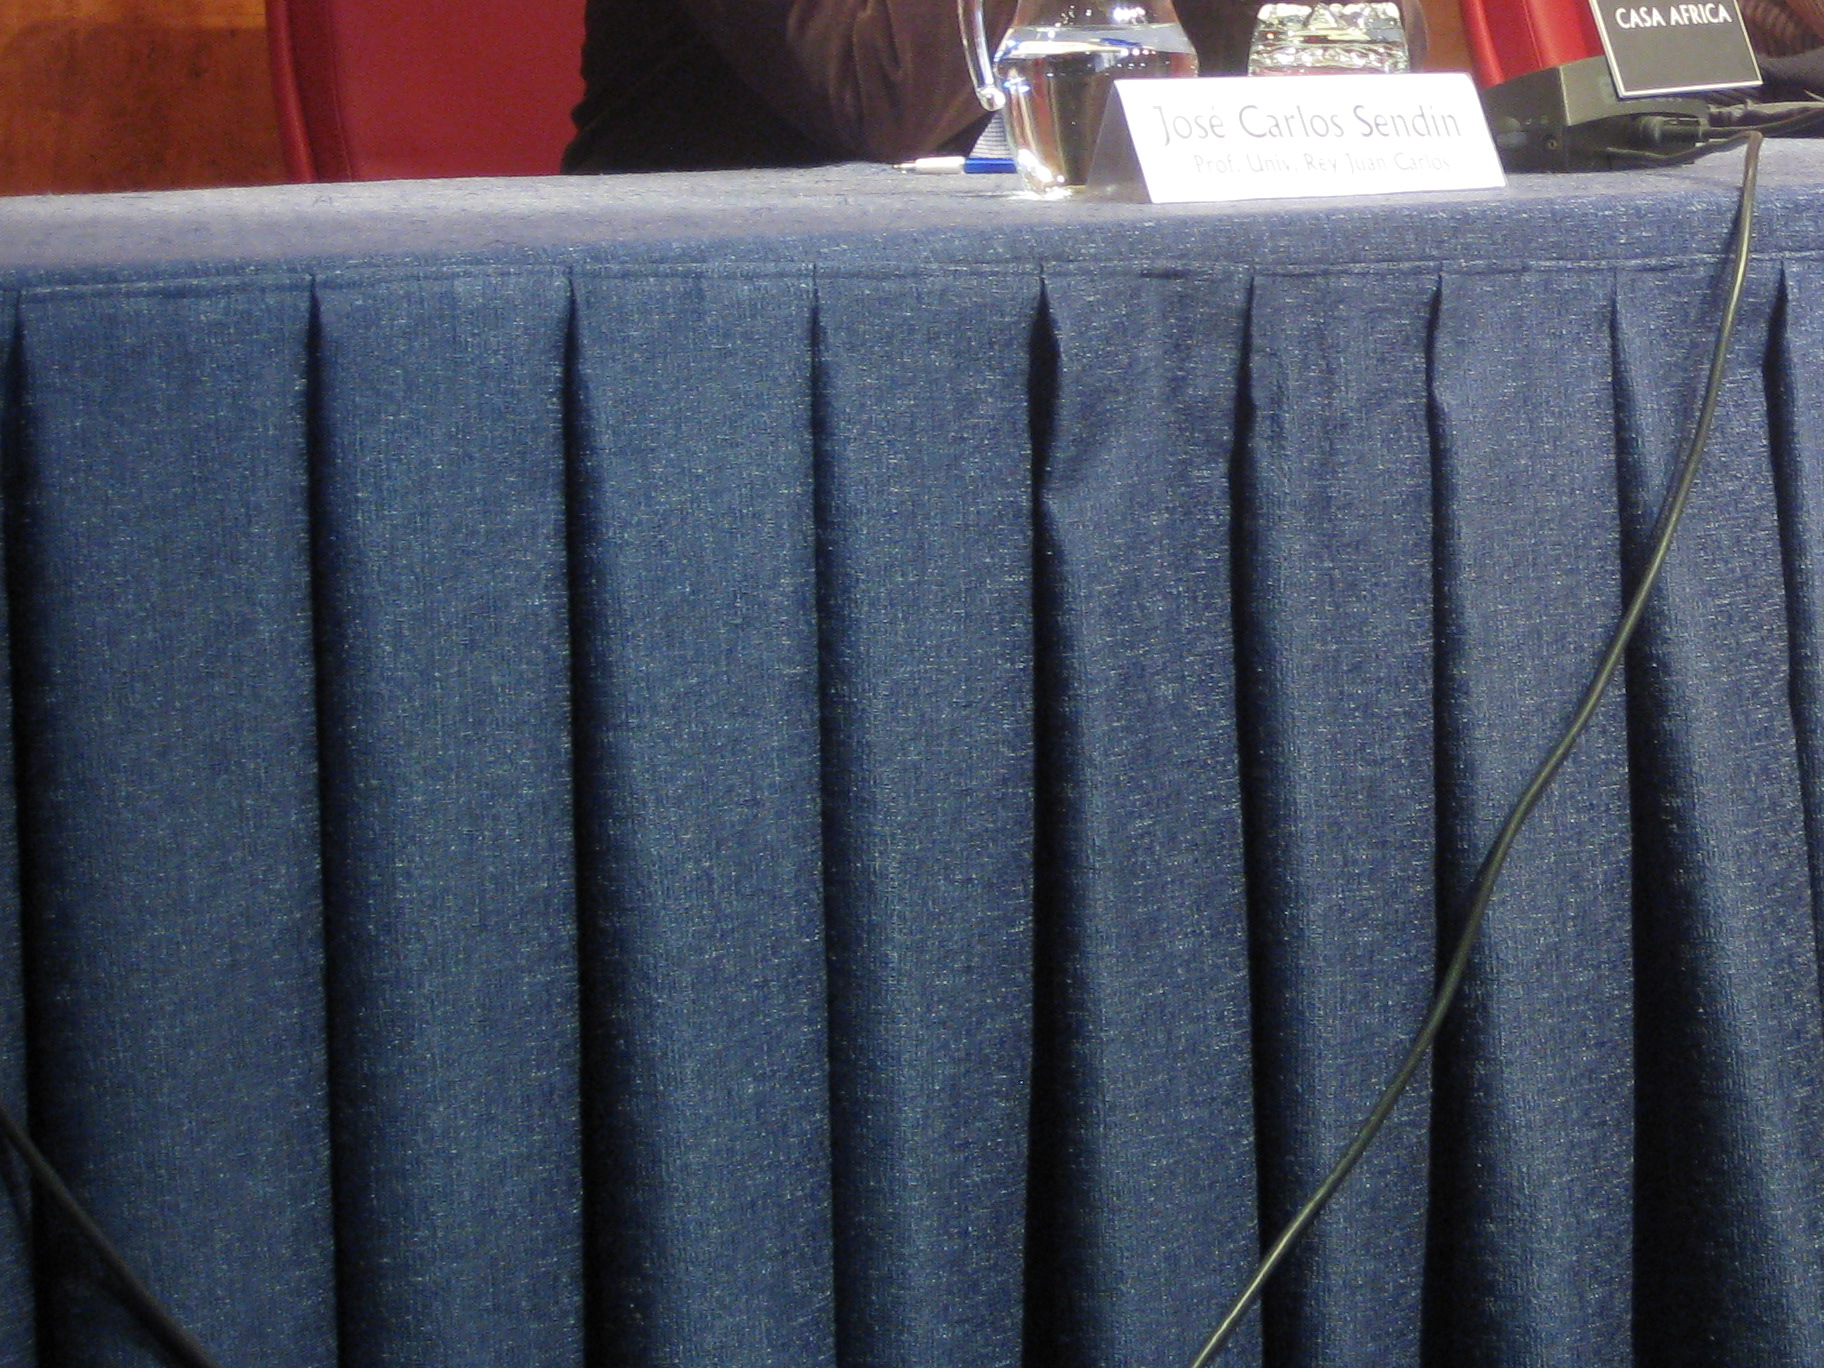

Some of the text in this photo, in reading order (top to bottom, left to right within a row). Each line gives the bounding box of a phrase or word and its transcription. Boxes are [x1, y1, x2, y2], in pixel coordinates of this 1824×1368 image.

[1614, 3, 1733, 30] CASA AFRICA
[1152, 104, 1462, 146] José Carlos Sendín
[1193, 151, 1451, 175] Prof. Univ. Rey Juan Carlos
